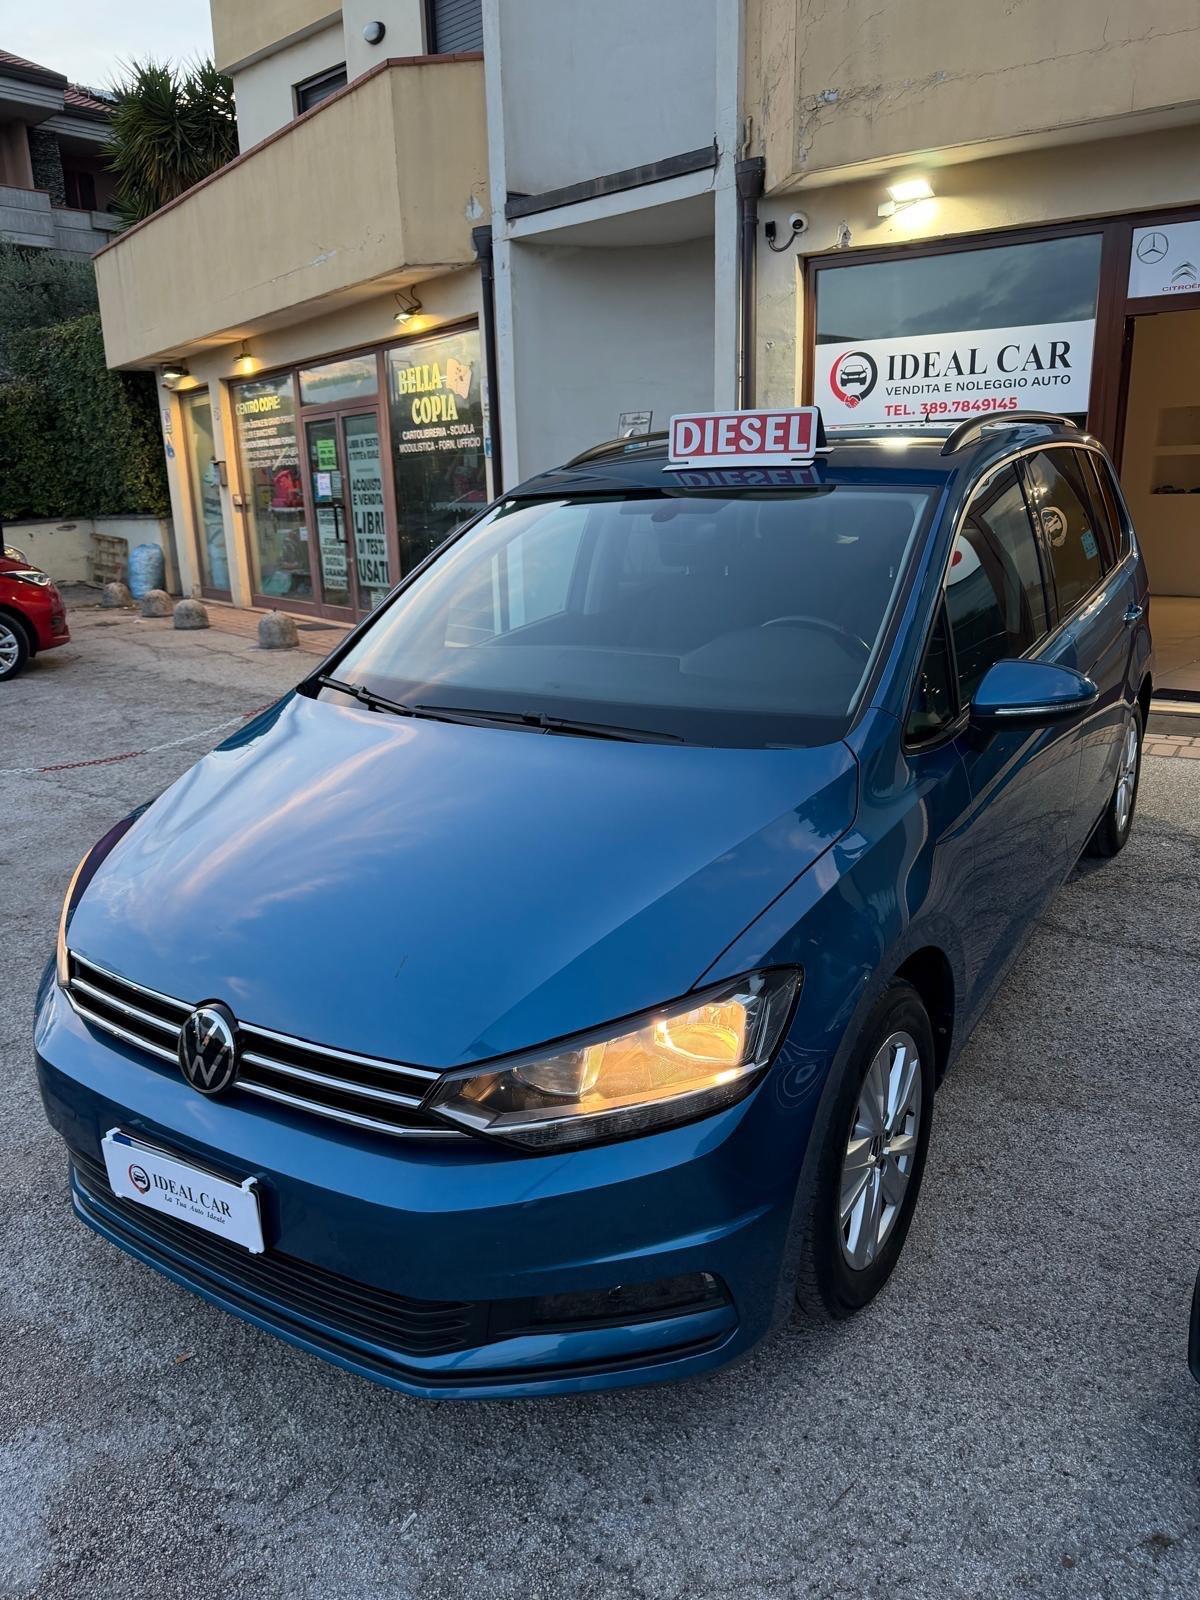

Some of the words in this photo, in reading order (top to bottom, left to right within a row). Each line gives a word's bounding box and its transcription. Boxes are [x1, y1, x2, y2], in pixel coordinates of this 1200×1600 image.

[885, 348, 988, 381] IDEAL
[997, 341, 1072, 373] CAR
[398, 362, 443, 395] BELLA
[886, 383, 941, 396] VENDITA
[944, 382, 952, 392] E
[956, 377, 1028, 391] NOLEGGIO
[1031, 375, 1072, 387] AUTO
[411, 394, 458, 425] COPIA
[885, 404, 916, 417] TEL.
[919, 397, 1018, 415] 389.7849145
[399, 441, 435, 453] MODULISTICA
[456, 437, 481, 448] UFFICIO
[402, 427, 447, 440] CARTOLIBRERIA
[450, 424, 475, 436] SCUOLA
[675, 416, 808, 454] DIESEL
[355, 511, 385, 534] LIBRI
[359, 559, 390, 584] USATI
[152, 1173, 198, 1204] IDEAL
[199, 1192, 233, 1218] CAR
[176, 1198, 187, 1209] Tua
[190, 1205, 205, 1216] Auto
[207, 1212, 226, 1225] Ideale
